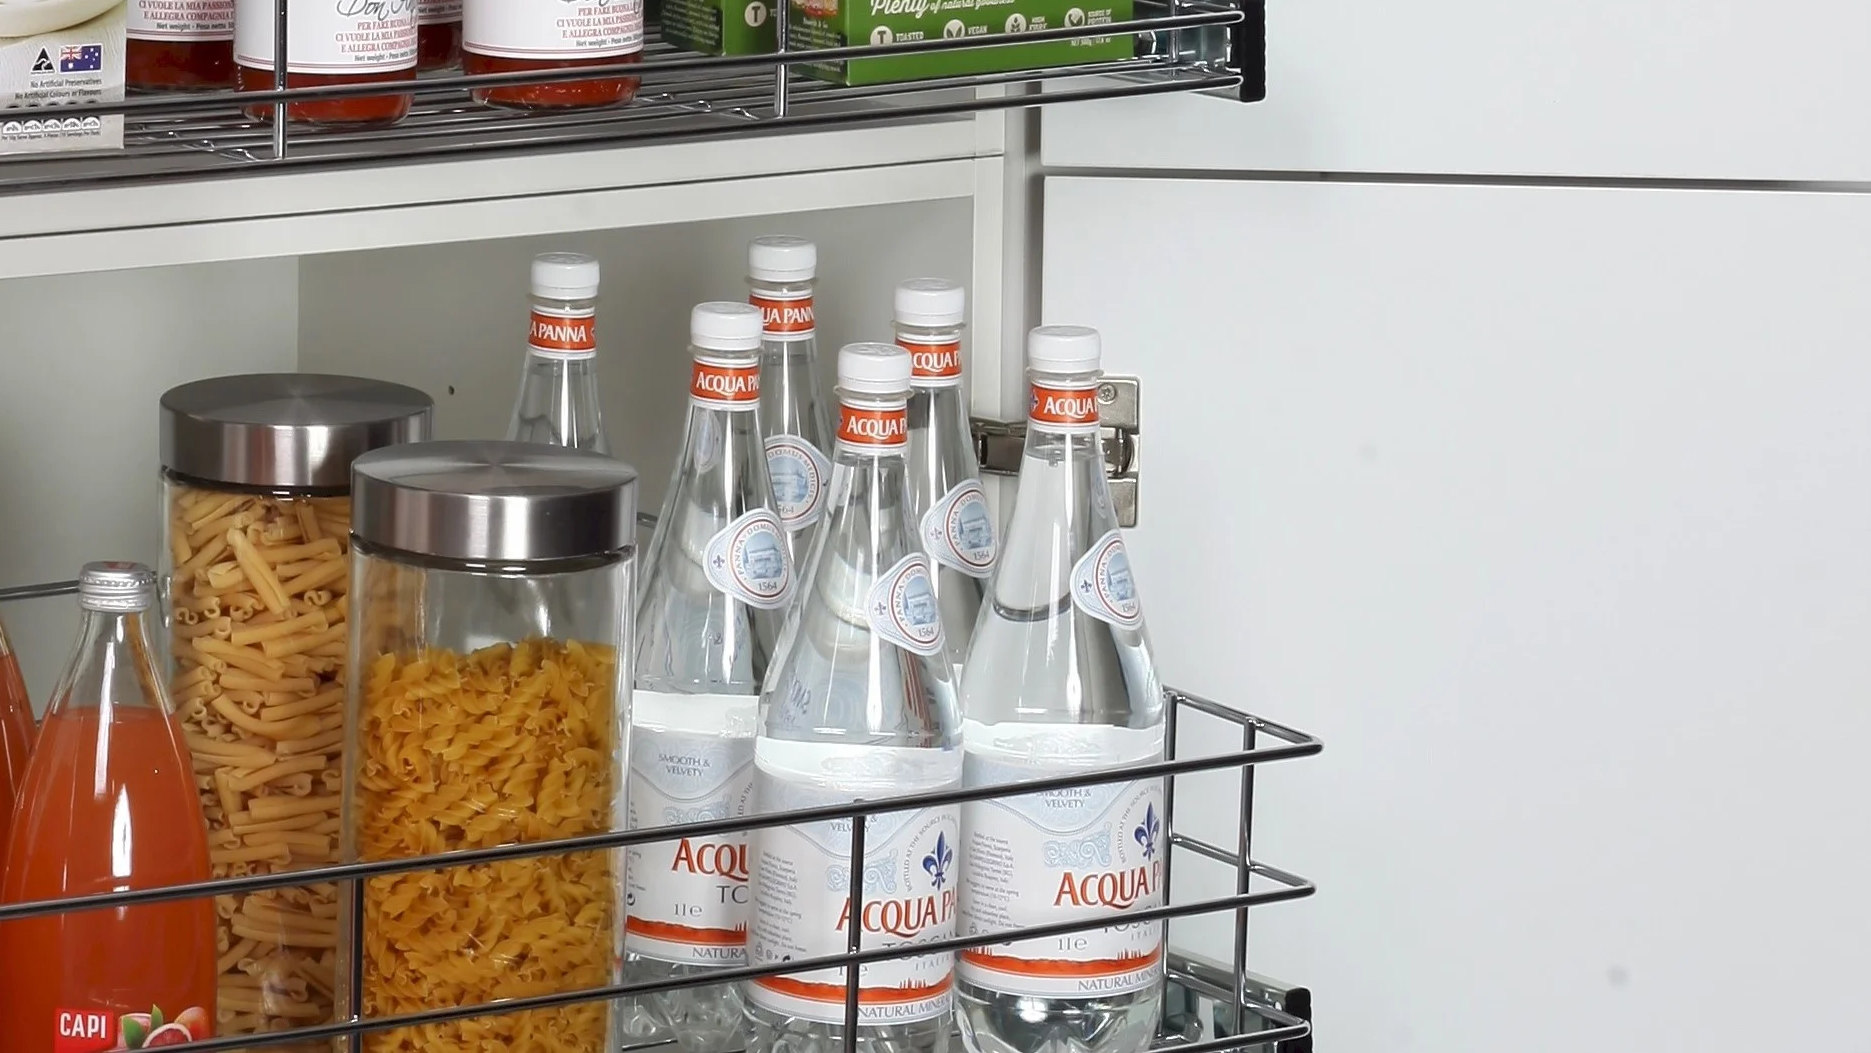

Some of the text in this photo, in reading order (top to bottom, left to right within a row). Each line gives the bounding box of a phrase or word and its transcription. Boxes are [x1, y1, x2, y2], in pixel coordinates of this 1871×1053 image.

[930, 1, 940, 14] of
[896, 31, 924, 42] TOASTED
[968, 25, 988, 35] VEGAN
[39, 79, 64, 88] Artificial
[64, 78, 102, 87] Preservatives
[24, 91, 49, 100] Artificial
[538, 323, 587, 343] PANNA
[696, 371, 746, 396] ACQUA
[1043, 396, 1094, 419] ACQUA
[846, 416, 898, 440] ACQUA
[973, 552, 990, 561] 1564
[758, 580, 778, 591] 1564
[918, 628, 935, 638] 1564
[658, 753, 711, 767] SMOOTH &
[665, 765, 704, 777] VELVETY
[1044, 799, 1085, 809] VELVETY
[1053, 866, 1150, 910] ACQUA
[1078, 975, 1134, 992] NATURAL
[857, 1003, 916, 1018] NATURAL
[60, 1012, 107, 1039] CAPI
